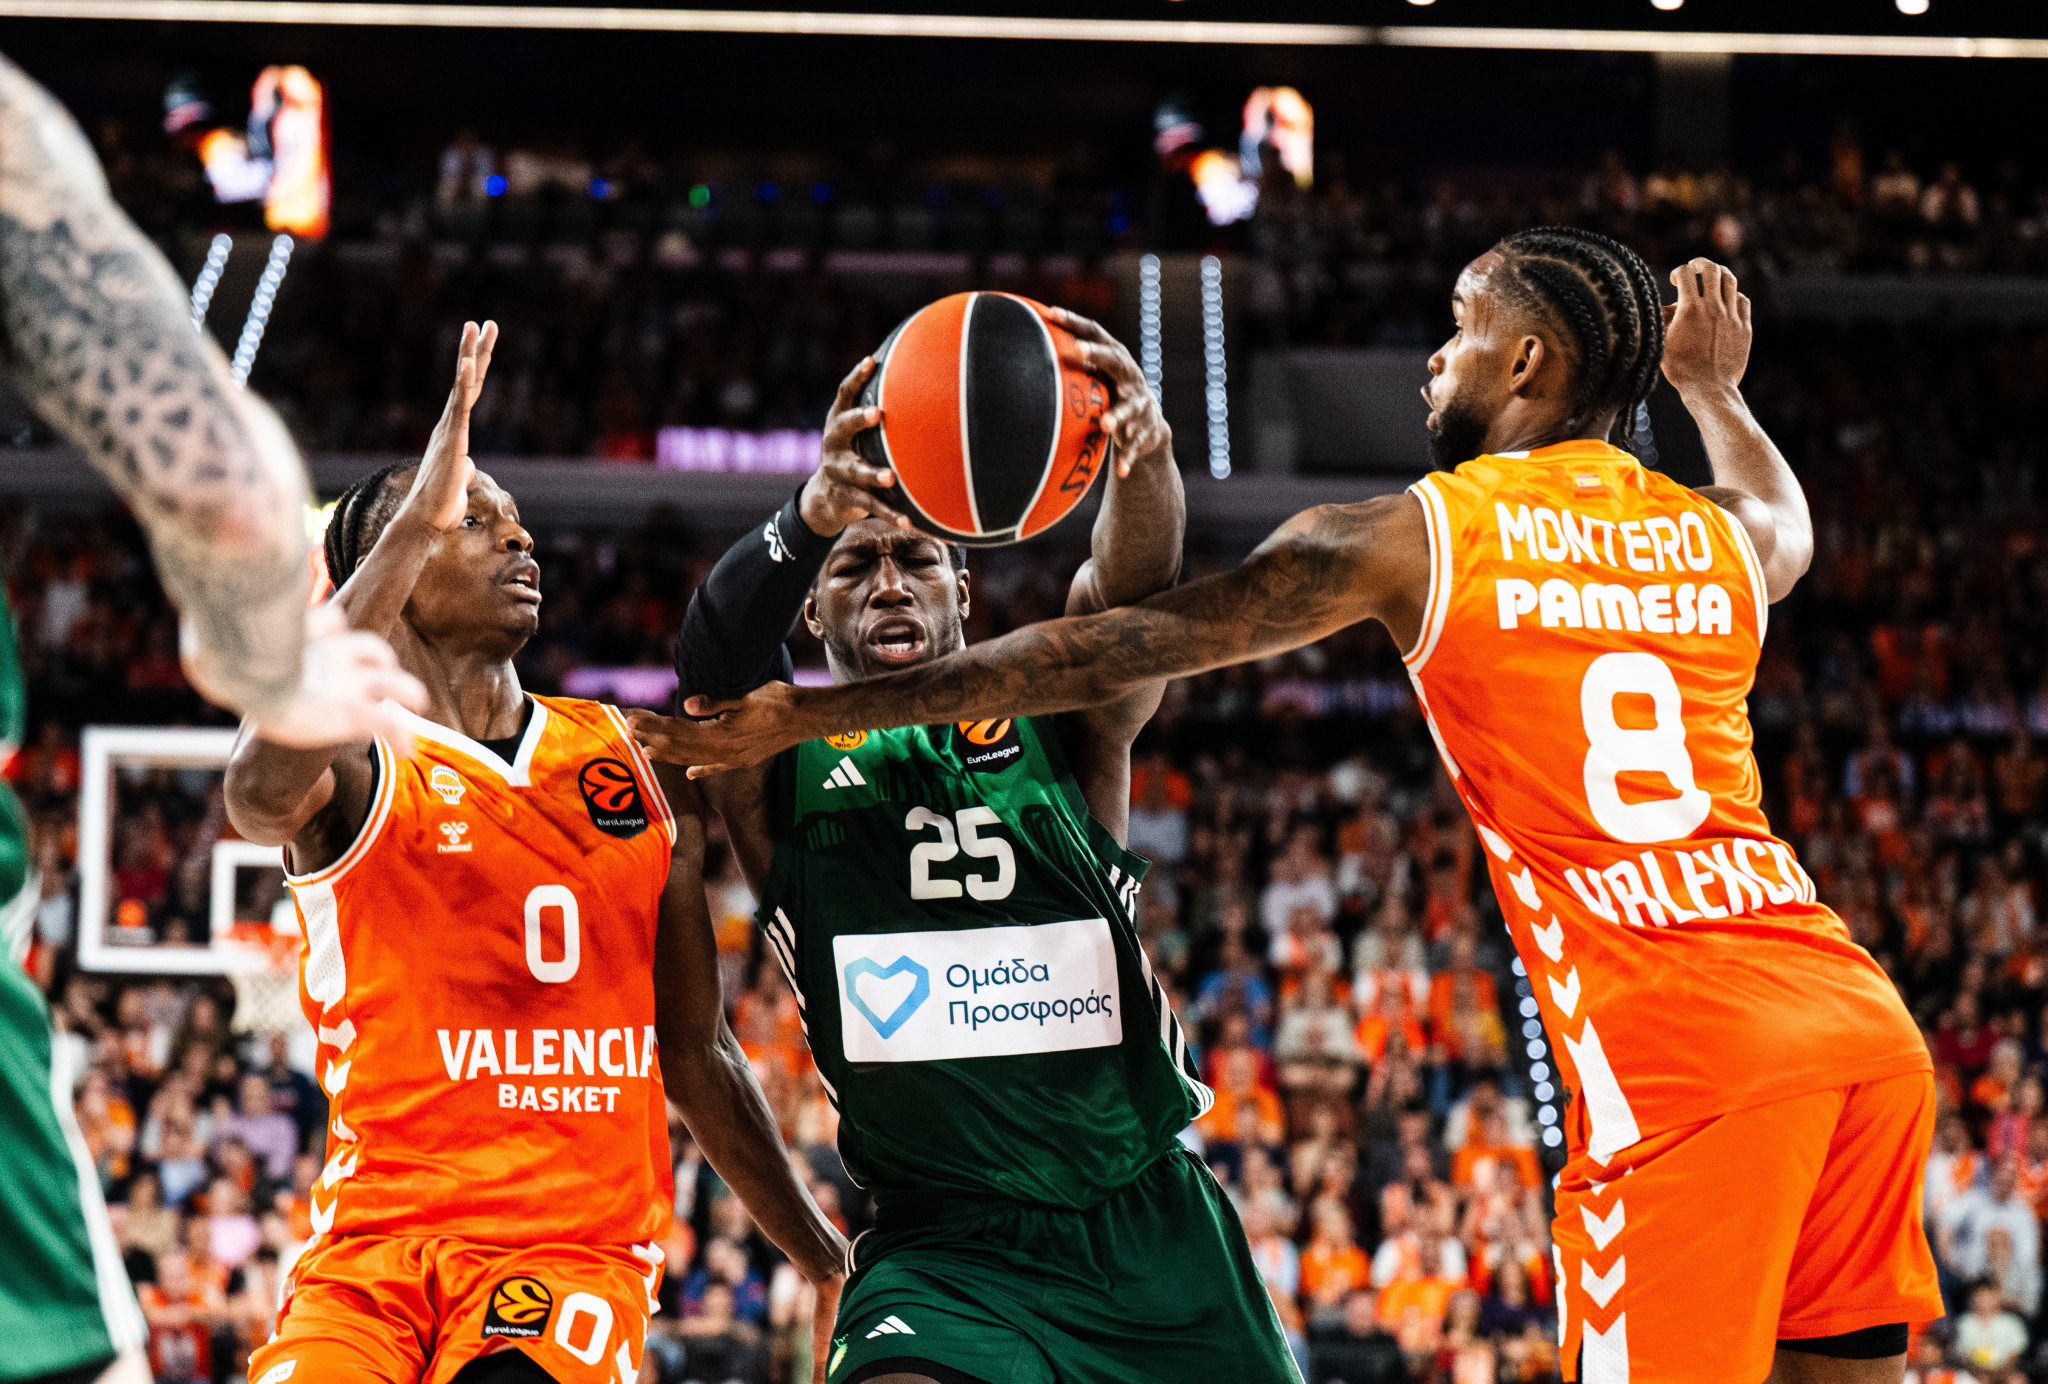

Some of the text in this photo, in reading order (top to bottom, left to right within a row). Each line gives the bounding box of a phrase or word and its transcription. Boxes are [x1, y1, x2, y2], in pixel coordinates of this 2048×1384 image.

[1494, 502, 1714, 573] MONTERO
[1495, 578, 1732, 635] PAMESA
[966, 745, 1020, 764] EuroLeague
[1580, 652, 1712, 843] 8
[437, 841, 473, 854] hummel
[596, 817, 645, 828] EuroLeague
[904, 806, 1017, 901] 25
[523, 884, 581, 984] 0
[945, 958, 1050, 993] Ομάδα
[948, 989, 1113, 1031] Προσφοράς
[436, 1024, 658, 1081] VALENCIA
[498, 1083, 622, 1113] BASKET
[554, 1291, 614, 1366] 0
